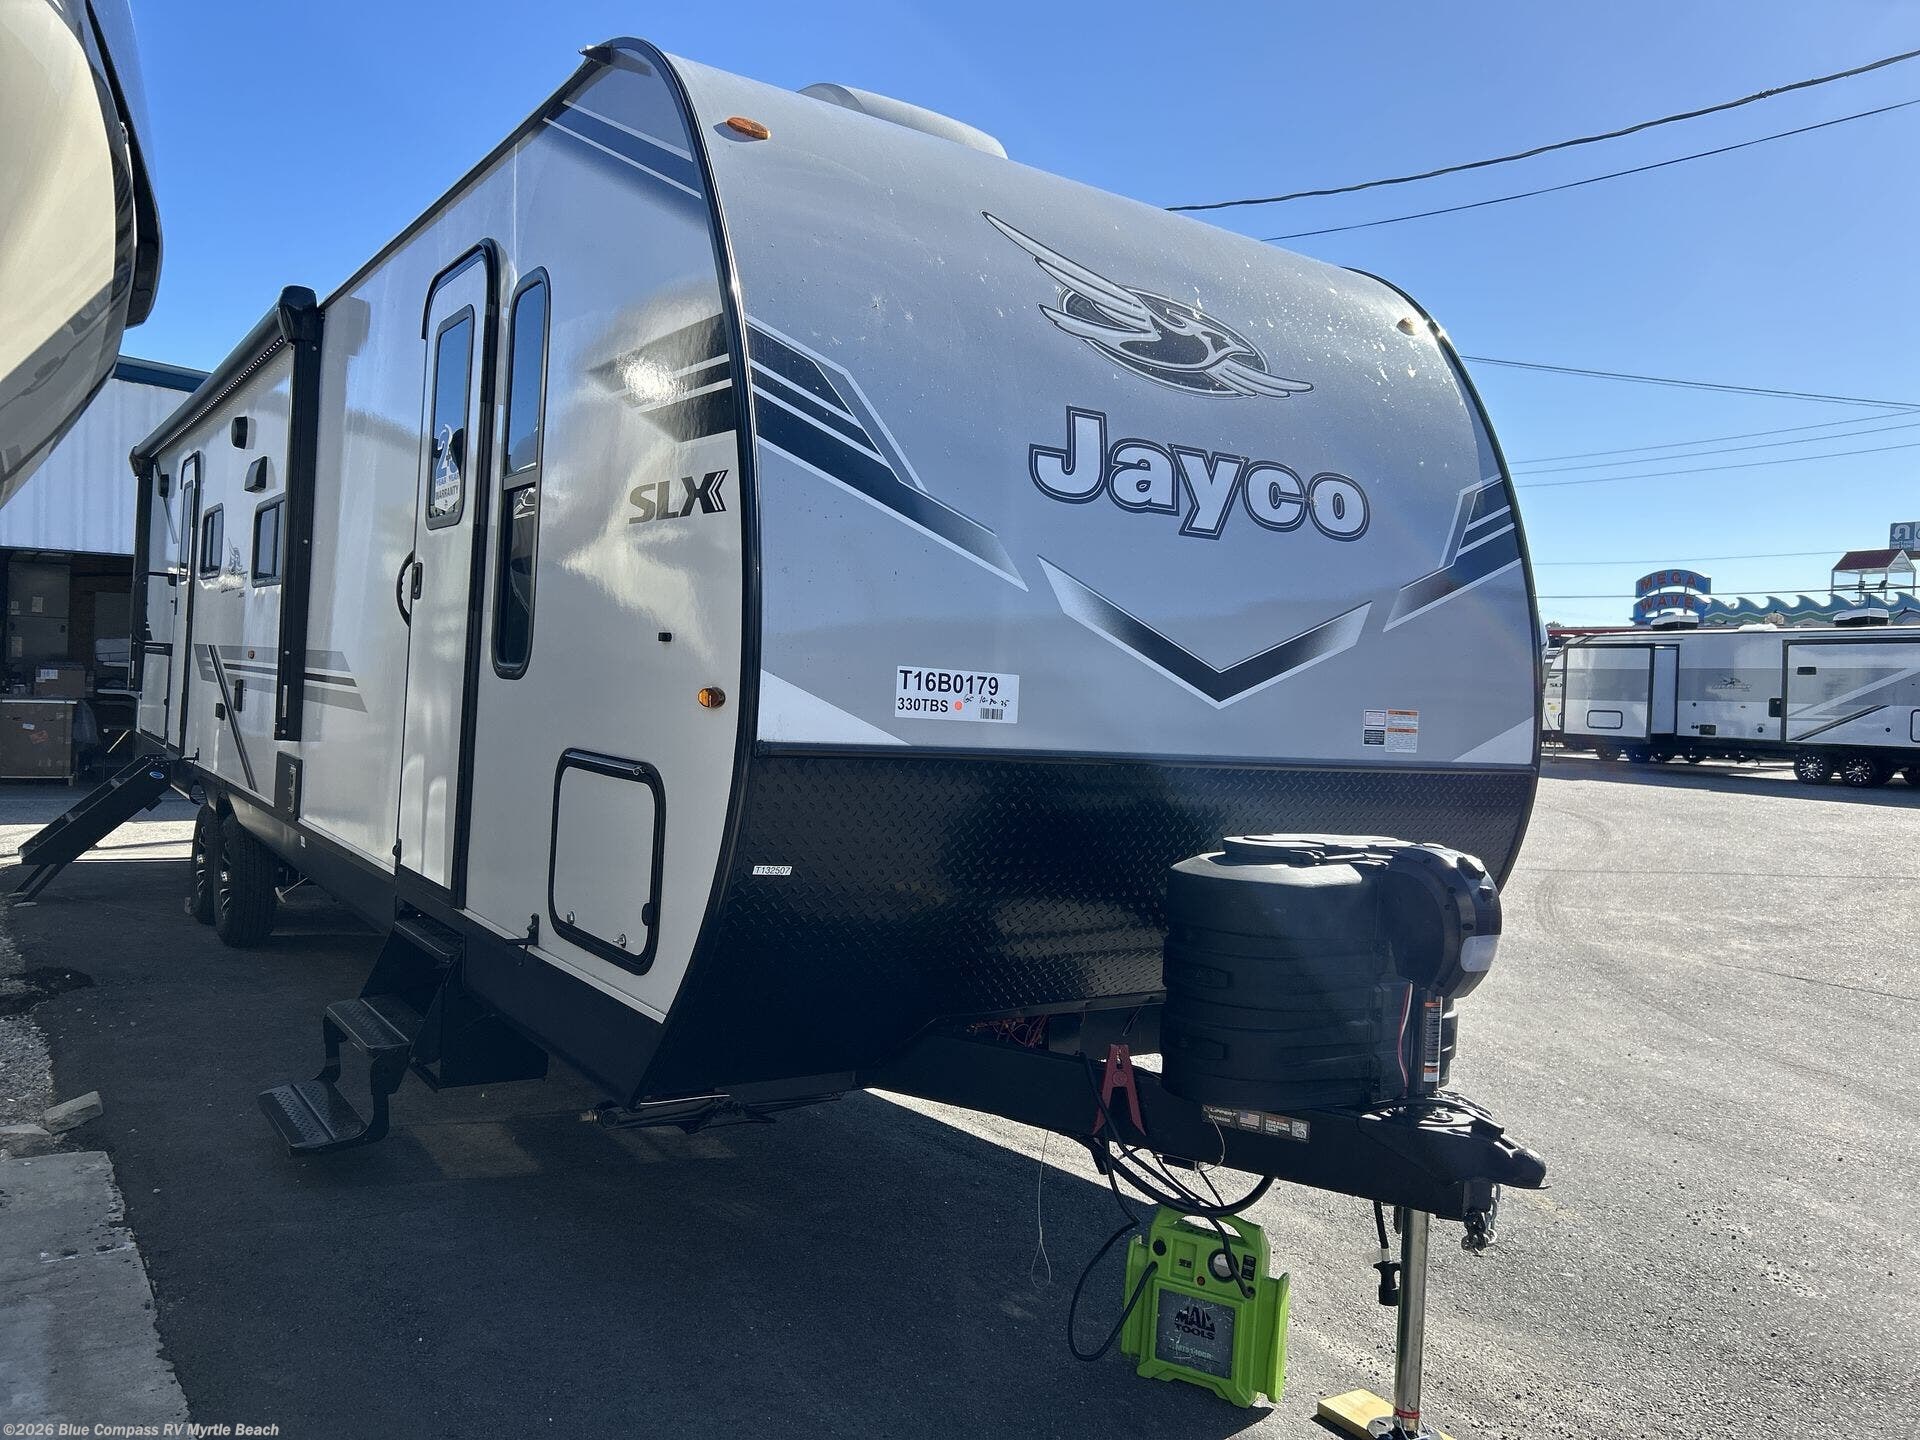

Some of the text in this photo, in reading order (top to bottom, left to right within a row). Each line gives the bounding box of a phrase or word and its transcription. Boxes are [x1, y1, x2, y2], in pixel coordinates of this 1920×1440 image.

[1028, 405, 1371, 542] Jayco
[435, 485, 460, 501] WARRANTY
[628, 470, 729, 525] SLX
[1640, 571, 1696, 589] MEGA
[1641, 595, 1695, 610] WAVE
[899, 669, 999, 696] T16B0179
[897, 697, 949, 713] 330TBS
[755, 866, 791, 875] T132507
[1174, 1322, 1216, 1341] TOOLS
